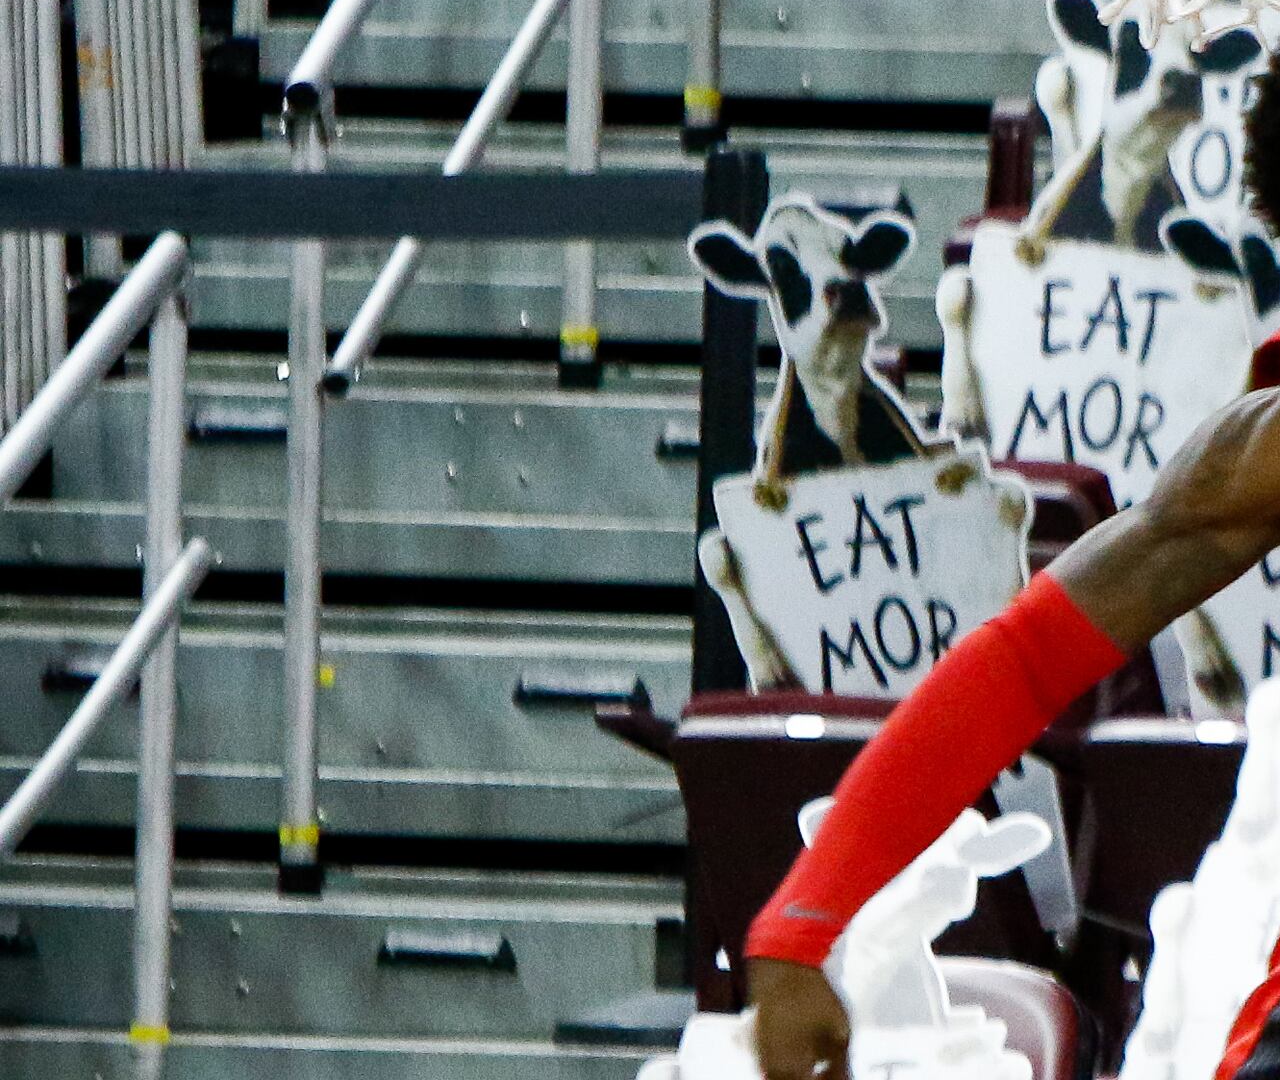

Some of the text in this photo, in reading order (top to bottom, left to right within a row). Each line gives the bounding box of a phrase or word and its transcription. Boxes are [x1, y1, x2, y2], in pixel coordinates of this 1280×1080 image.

[1038, 272, 1177, 364] EAT
[1007, 374, 1163, 469] MOR
[796, 492, 926, 594] EAT
